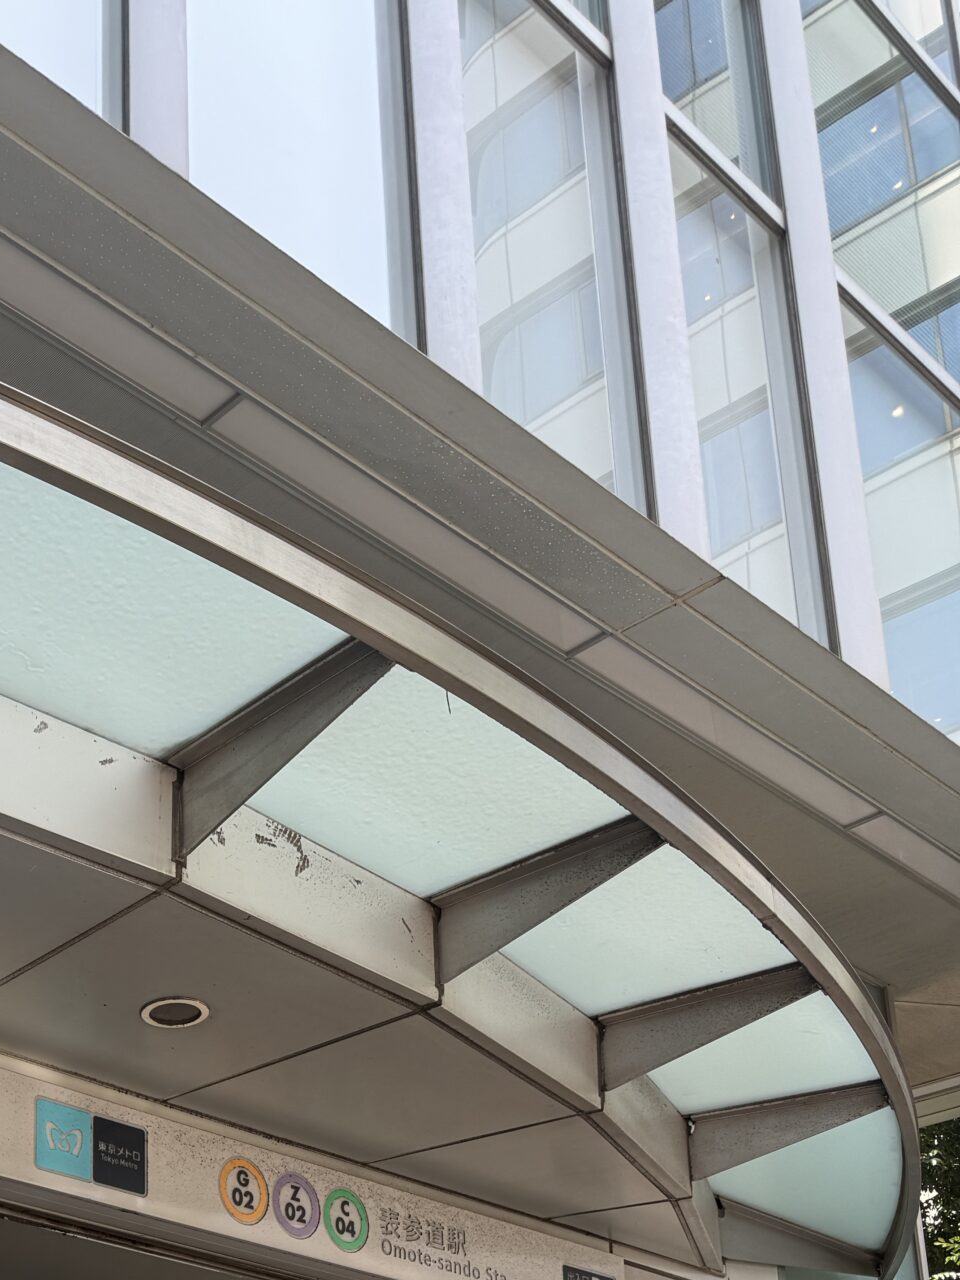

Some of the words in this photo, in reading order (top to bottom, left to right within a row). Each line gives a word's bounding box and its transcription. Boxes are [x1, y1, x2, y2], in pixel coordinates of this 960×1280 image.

[98, 1141, 140, 1161] 東京メトロ
[100, 1155, 118, 1166] Tokyo
[120, 1158, 138, 1170] Metro
[236, 1170, 249, 1188] G
[232, 1188, 254, 1210] 02
[291, 1185, 300, 1202] Z
[284, 1202, 306, 1224] 02
[340, 1200, 350, 1216] C
[335, 1216, 356, 1238] 04
[378, 1208, 467, 1256] 表参道駅
[381, 1239, 480, 1280] Omote-sando
